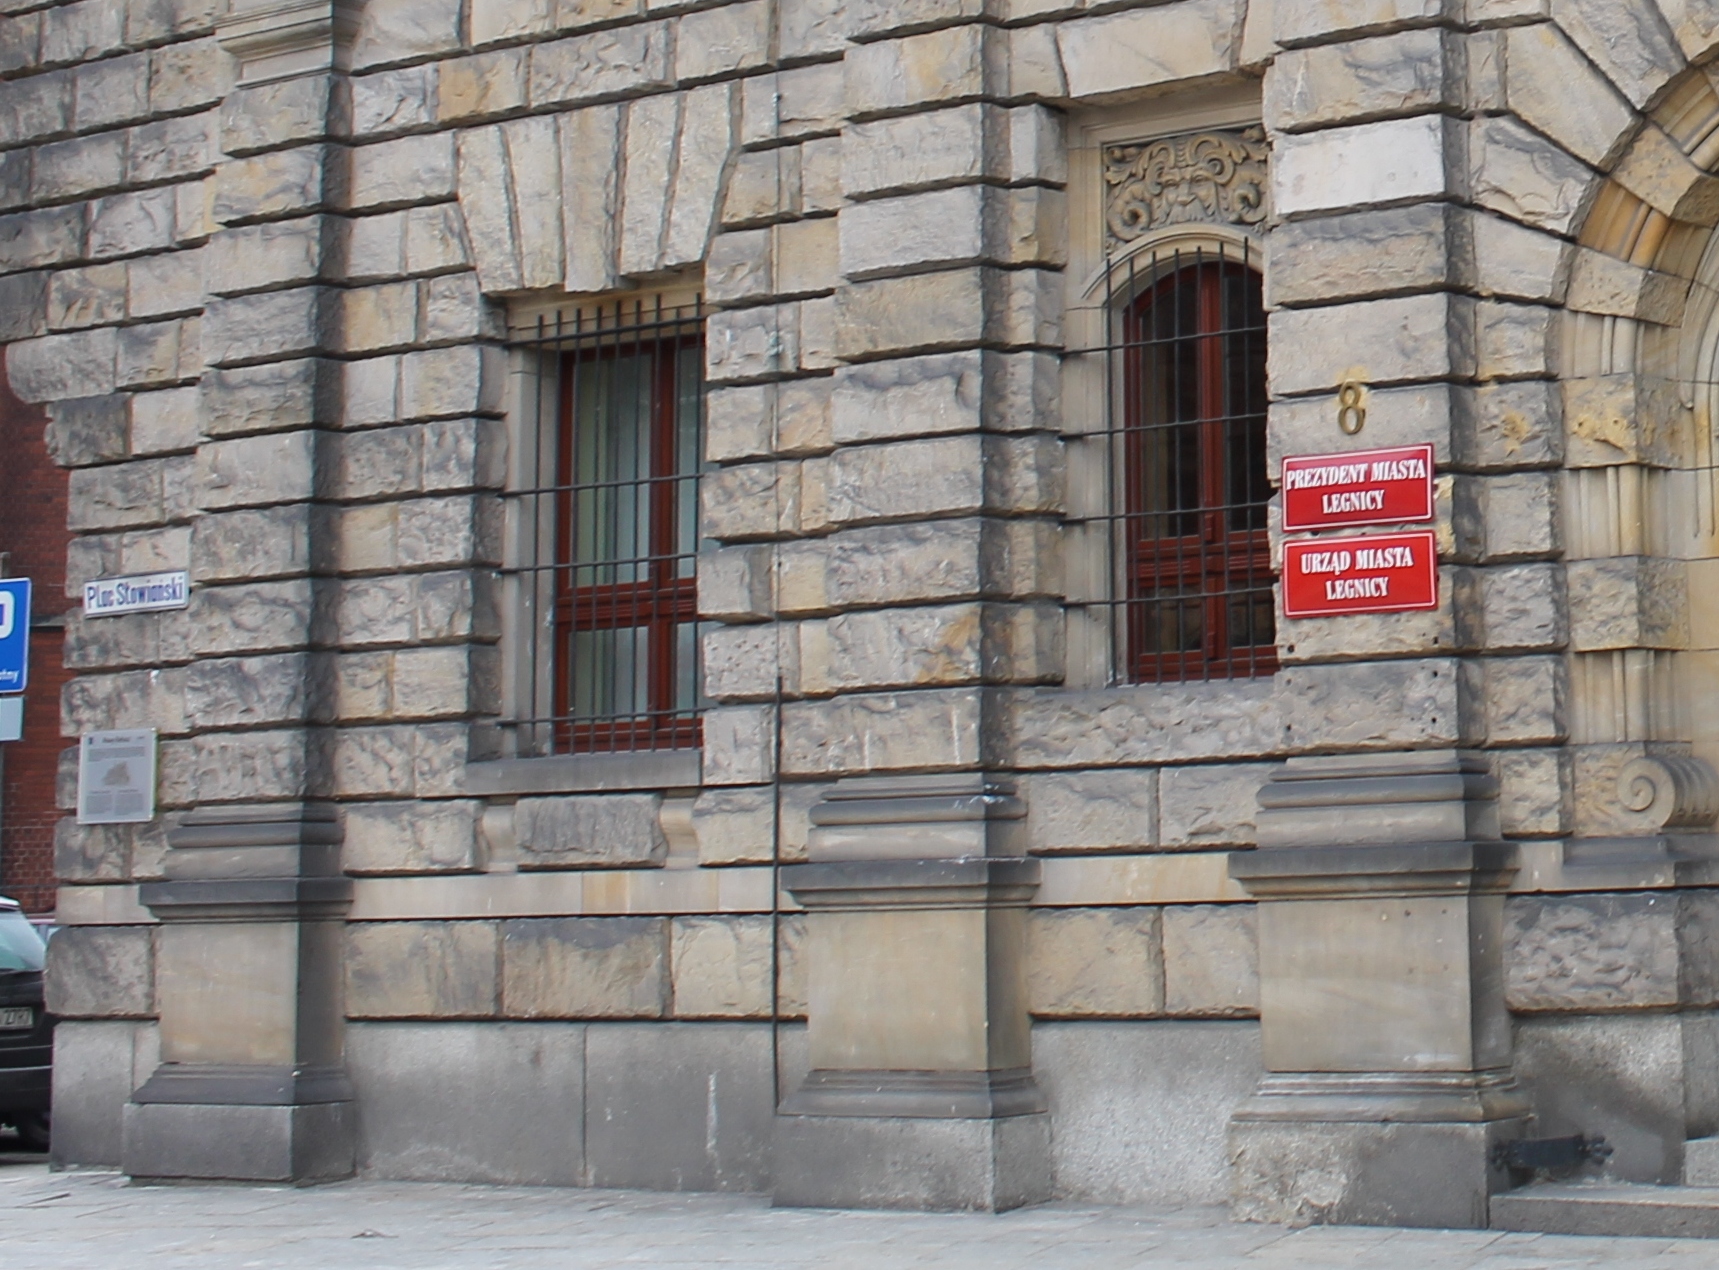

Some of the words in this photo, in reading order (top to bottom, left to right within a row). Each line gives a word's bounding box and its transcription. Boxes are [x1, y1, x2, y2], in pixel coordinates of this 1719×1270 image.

[1338, 380, 1365, 434] 8
[1286, 463, 1367, 490] PREZYDENT
[1370, 458, 1426, 483] MIASTA
[1322, 489, 1385, 514] LEGNICY
[1301, 552, 1351, 575] URZĄD
[1355, 546, 1413, 570] MIASTA
[1326, 576, 1389, 600] LEGNICY
